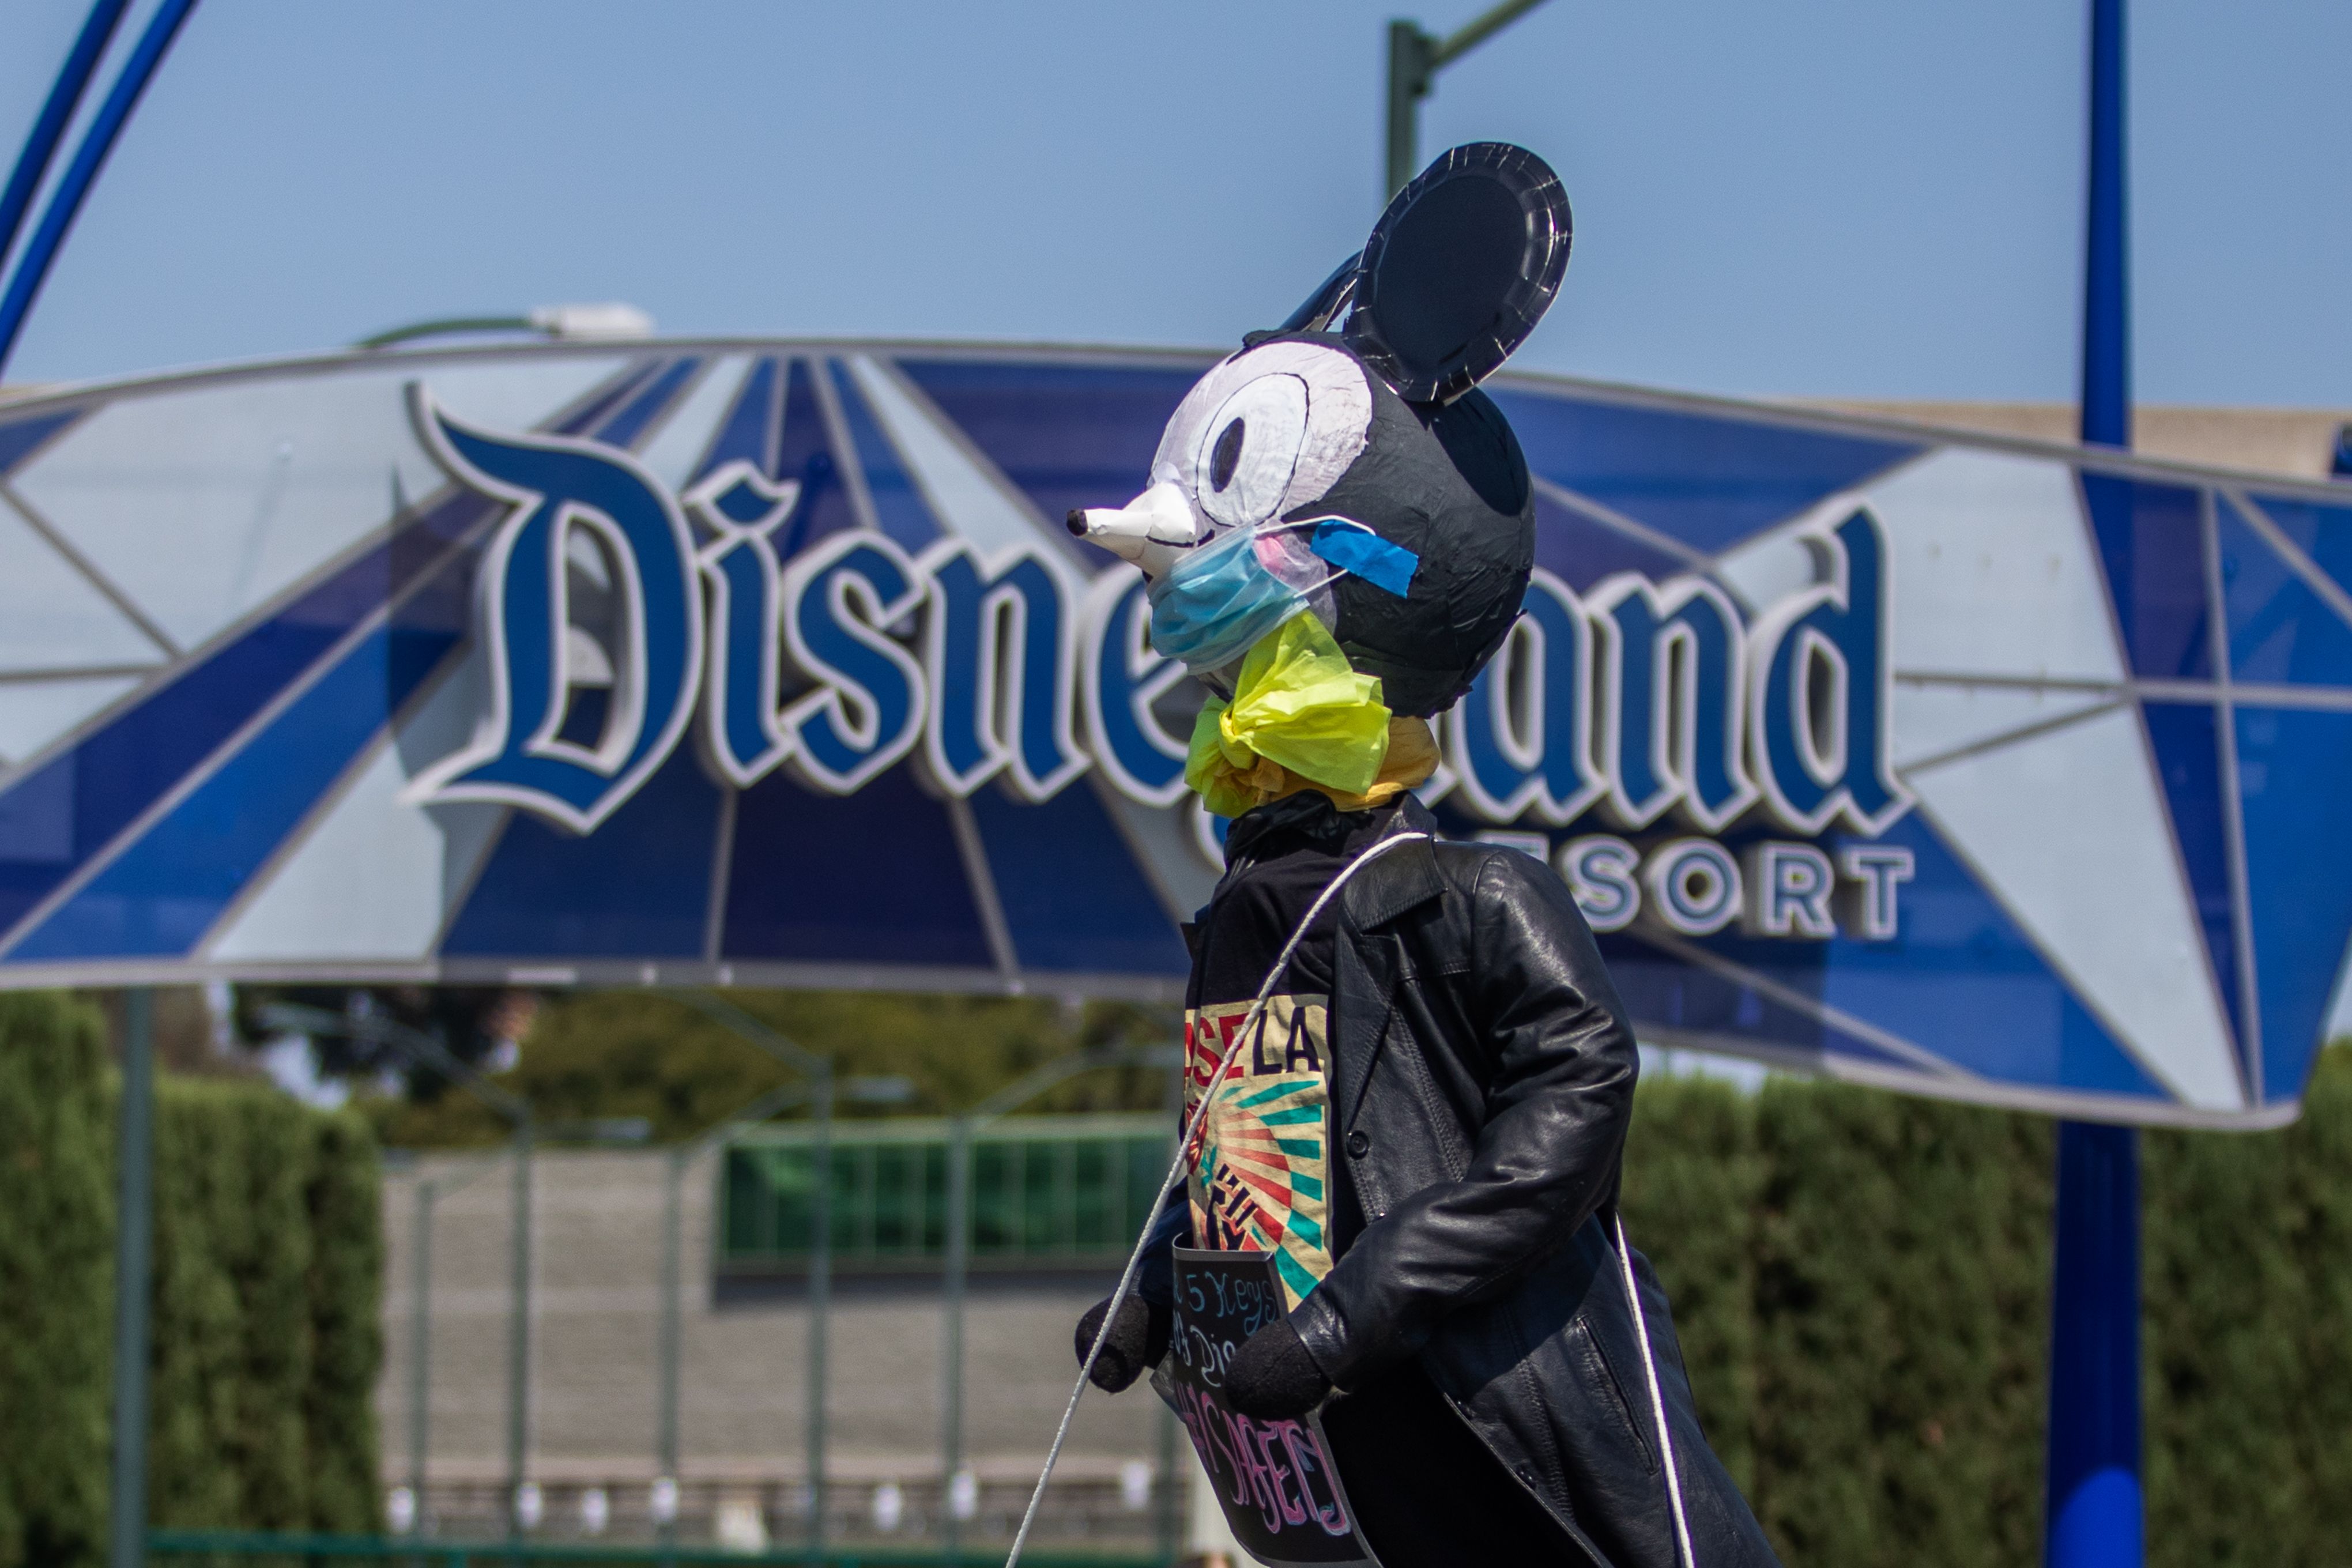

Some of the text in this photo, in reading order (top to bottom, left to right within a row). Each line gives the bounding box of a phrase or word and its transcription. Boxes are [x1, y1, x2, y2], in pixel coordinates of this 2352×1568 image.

[399, 379, 1918, 874] Disneand
[1435, 830, 1915, 941] SORT
[1253, 1006, 1321, 1076] LA
[1186, 1273, 1206, 1312] 5
